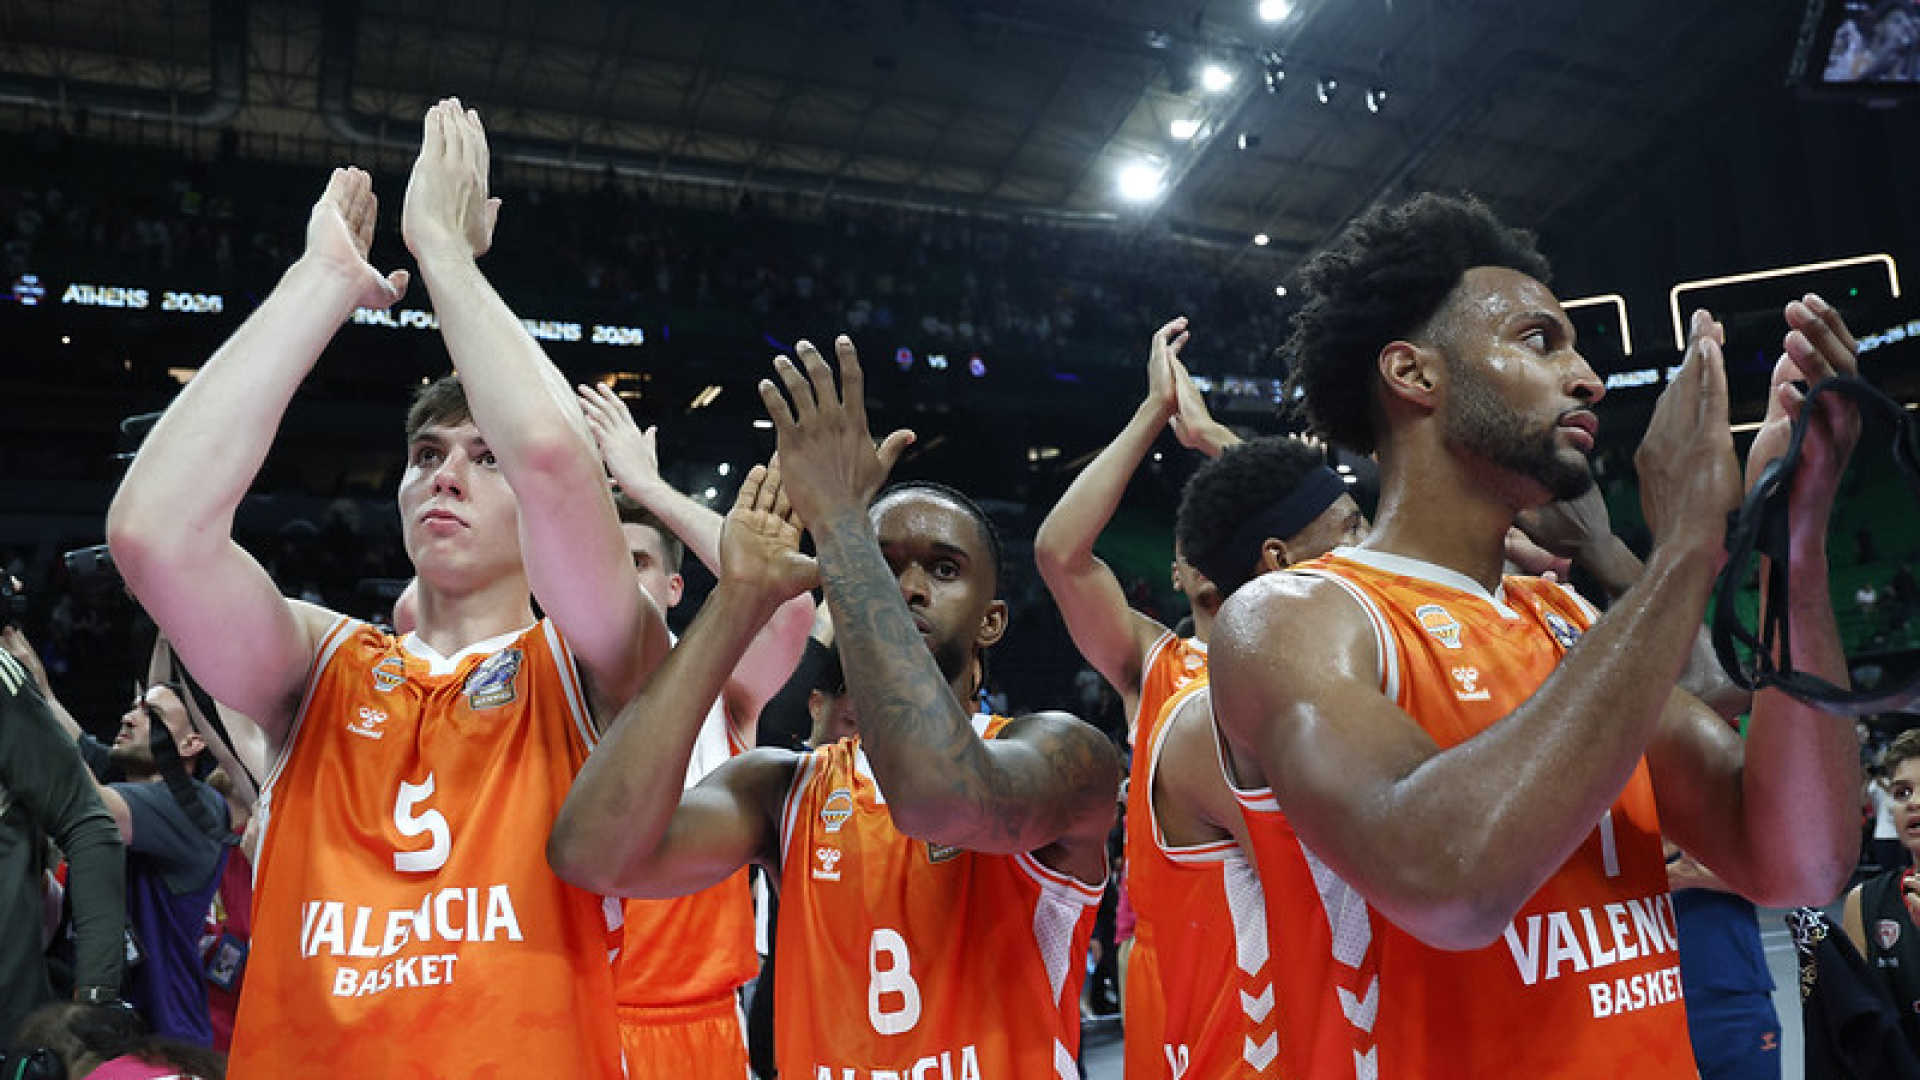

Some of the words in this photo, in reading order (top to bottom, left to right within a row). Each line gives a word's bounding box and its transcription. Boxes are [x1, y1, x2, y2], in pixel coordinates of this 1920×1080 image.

[62, 283, 149, 307] ATHENS
[161, 291, 224, 313] 2026
[353, 307, 398, 328] INAL
[592, 324, 644, 346] 2026
[393, 771, 451, 872] 5
[302, 883, 523, 958] VALENCIA
[333, 952, 458, 997] BASKET
[868, 928, 922, 1035] 8
